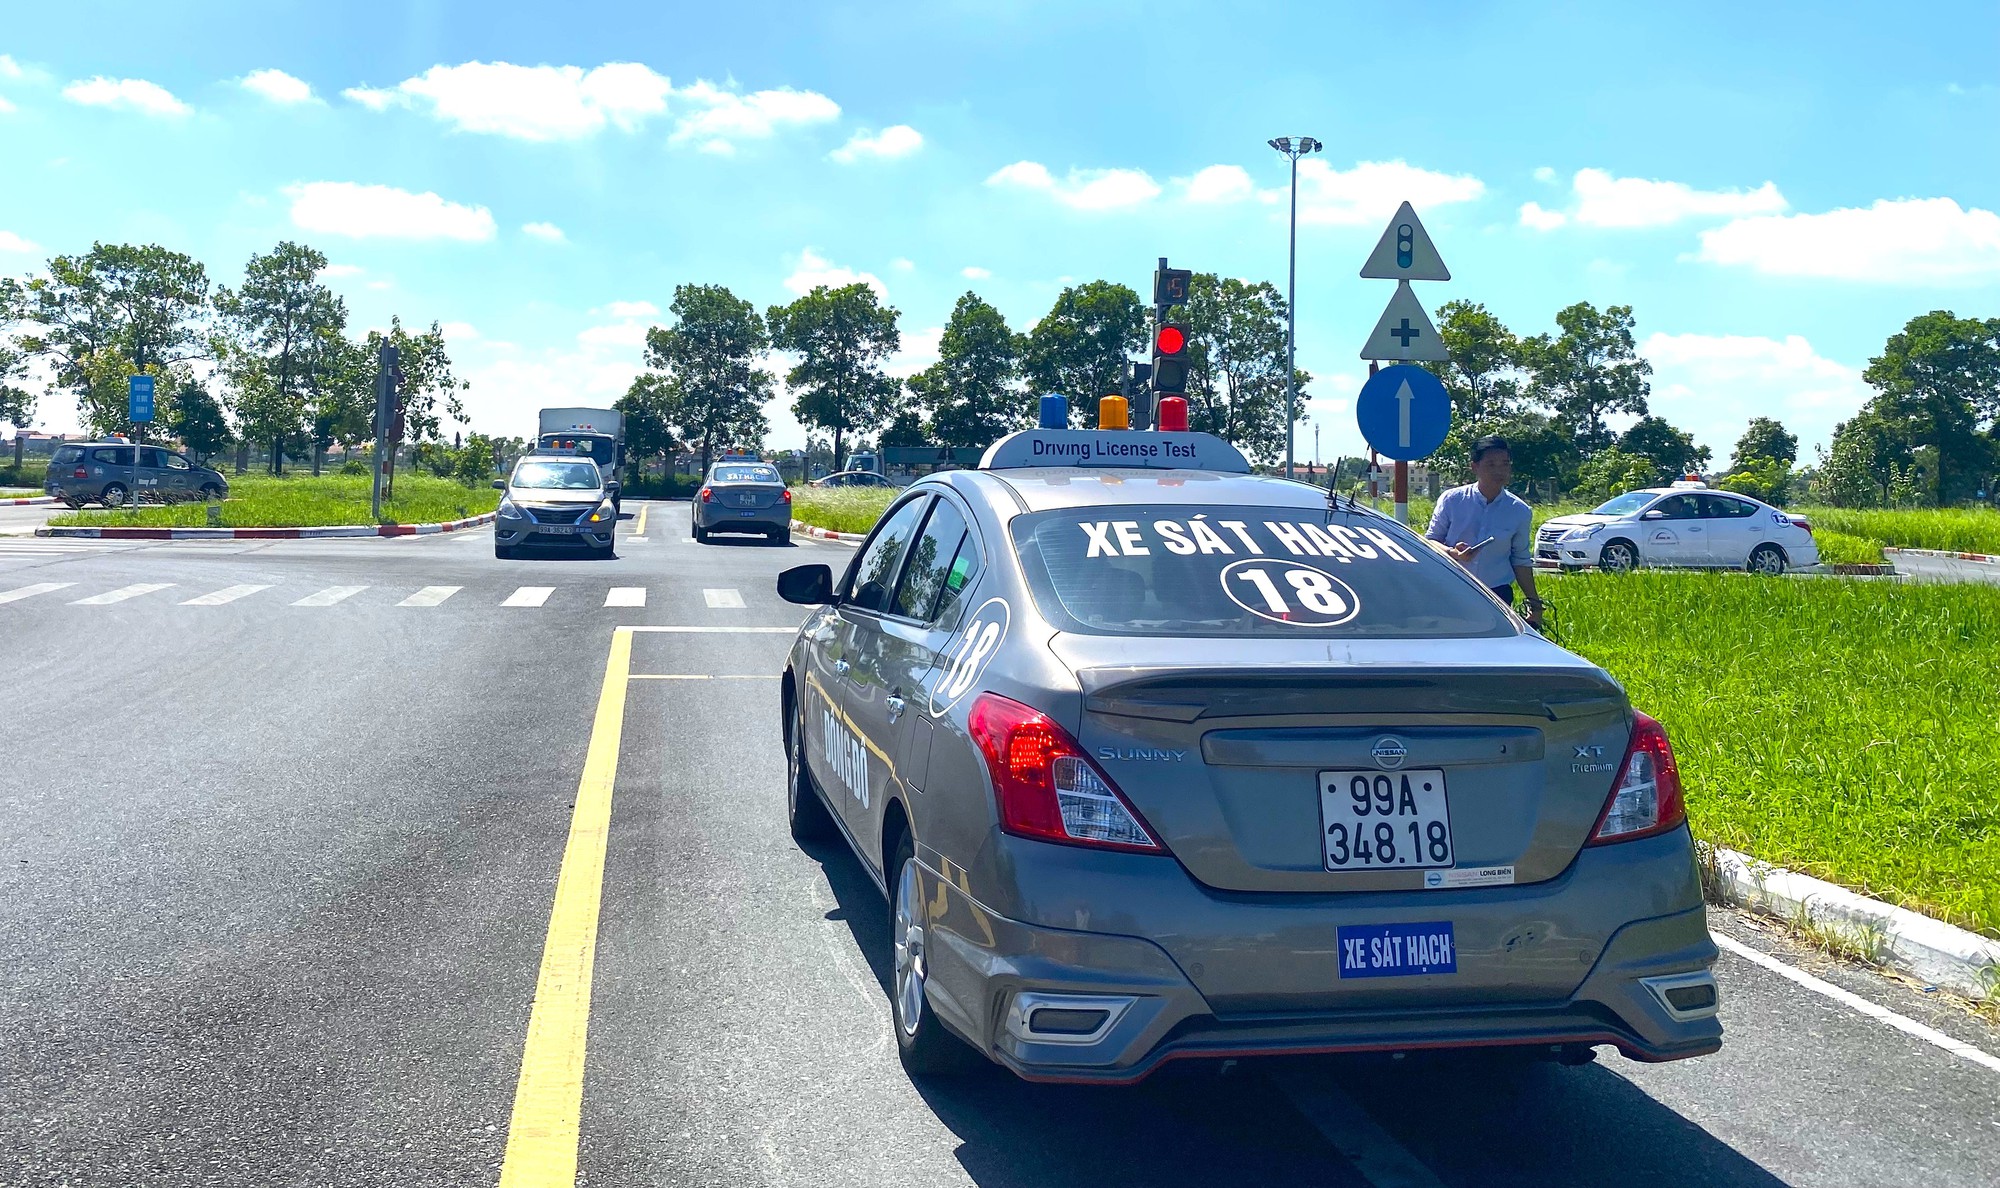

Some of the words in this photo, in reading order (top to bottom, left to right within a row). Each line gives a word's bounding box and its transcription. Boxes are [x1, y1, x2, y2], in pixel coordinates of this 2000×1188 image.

[1033, 439, 1090, 459] Driving
[1096, 440, 1158, 457] License
[1163, 441, 1196, 458] Test
[1078, 520, 1150, 558] XE
[1154, 513, 1264, 556] SÁT
[1263, 520, 1420, 563] HẠCH
[1772, 514, 1789, 523] 13
[1237, 568, 1347, 616] 18
[937, 620, 1000, 700] 18
[1098, 746, 1188, 762] SUNNY
[1571, 761, 1613, 773] Premium
[1573, 745, 1605, 758] XT
[1350, 774, 1418, 816] 99A
[1327, 820, 1449, 865] 348.18
[1344, 938, 1366, 969] XE
[1371, 930, 1402, 968] SÁT
[1406, 933, 1451, 972] HẠCH
